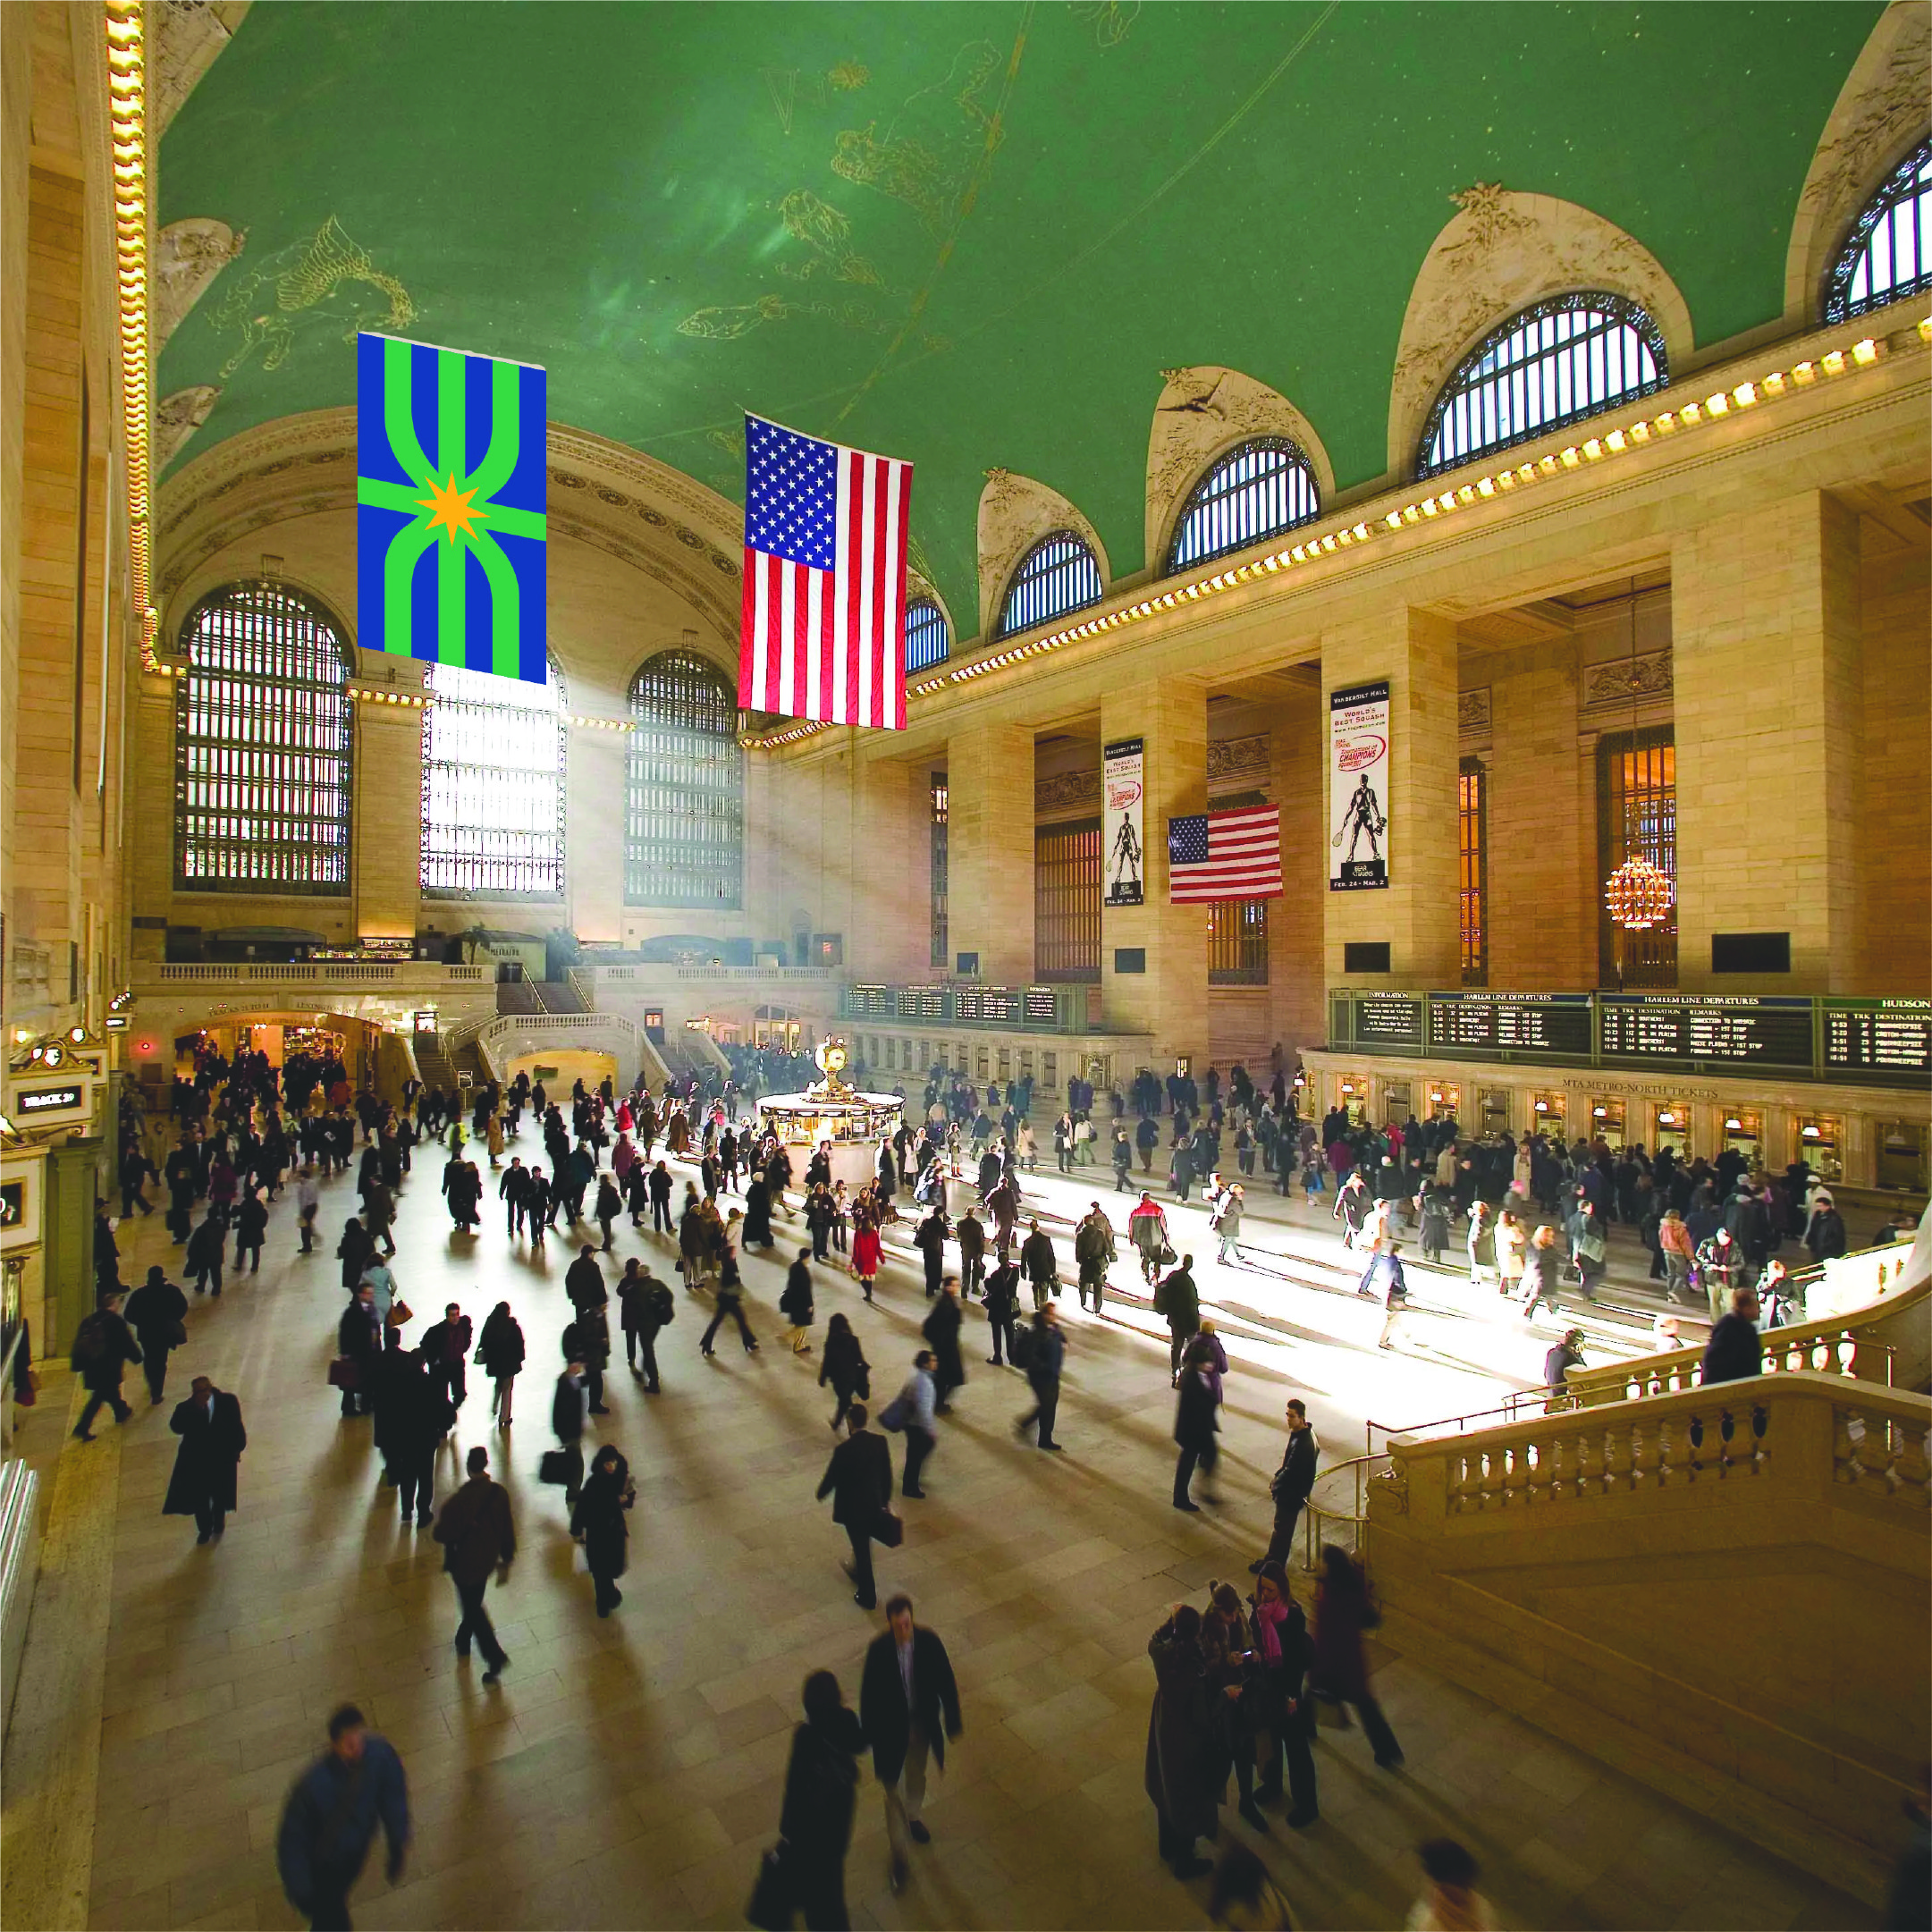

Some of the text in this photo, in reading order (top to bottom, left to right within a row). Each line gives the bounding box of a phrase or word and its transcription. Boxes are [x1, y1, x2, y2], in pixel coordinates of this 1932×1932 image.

[1334, 689, 1388, 704] VANDERBILT HALL
[1344, 706, 1376, 718] WORLD'S
[1355, 713, 1385, 723] SQUASH
[1339, 749, 1377, 763] CHAMPIONS
[1703, 997, 1759, 1005] DEPARTURES
[1882, 1000, 1932, 1008] HUDSON
[1875, 1013, 1932, 1021] DESTINATION
[1563, 1078, 1718, 1099] MTA METRO-NORTH TICKETS
[22, 1093, 63, 1109] TRACK
